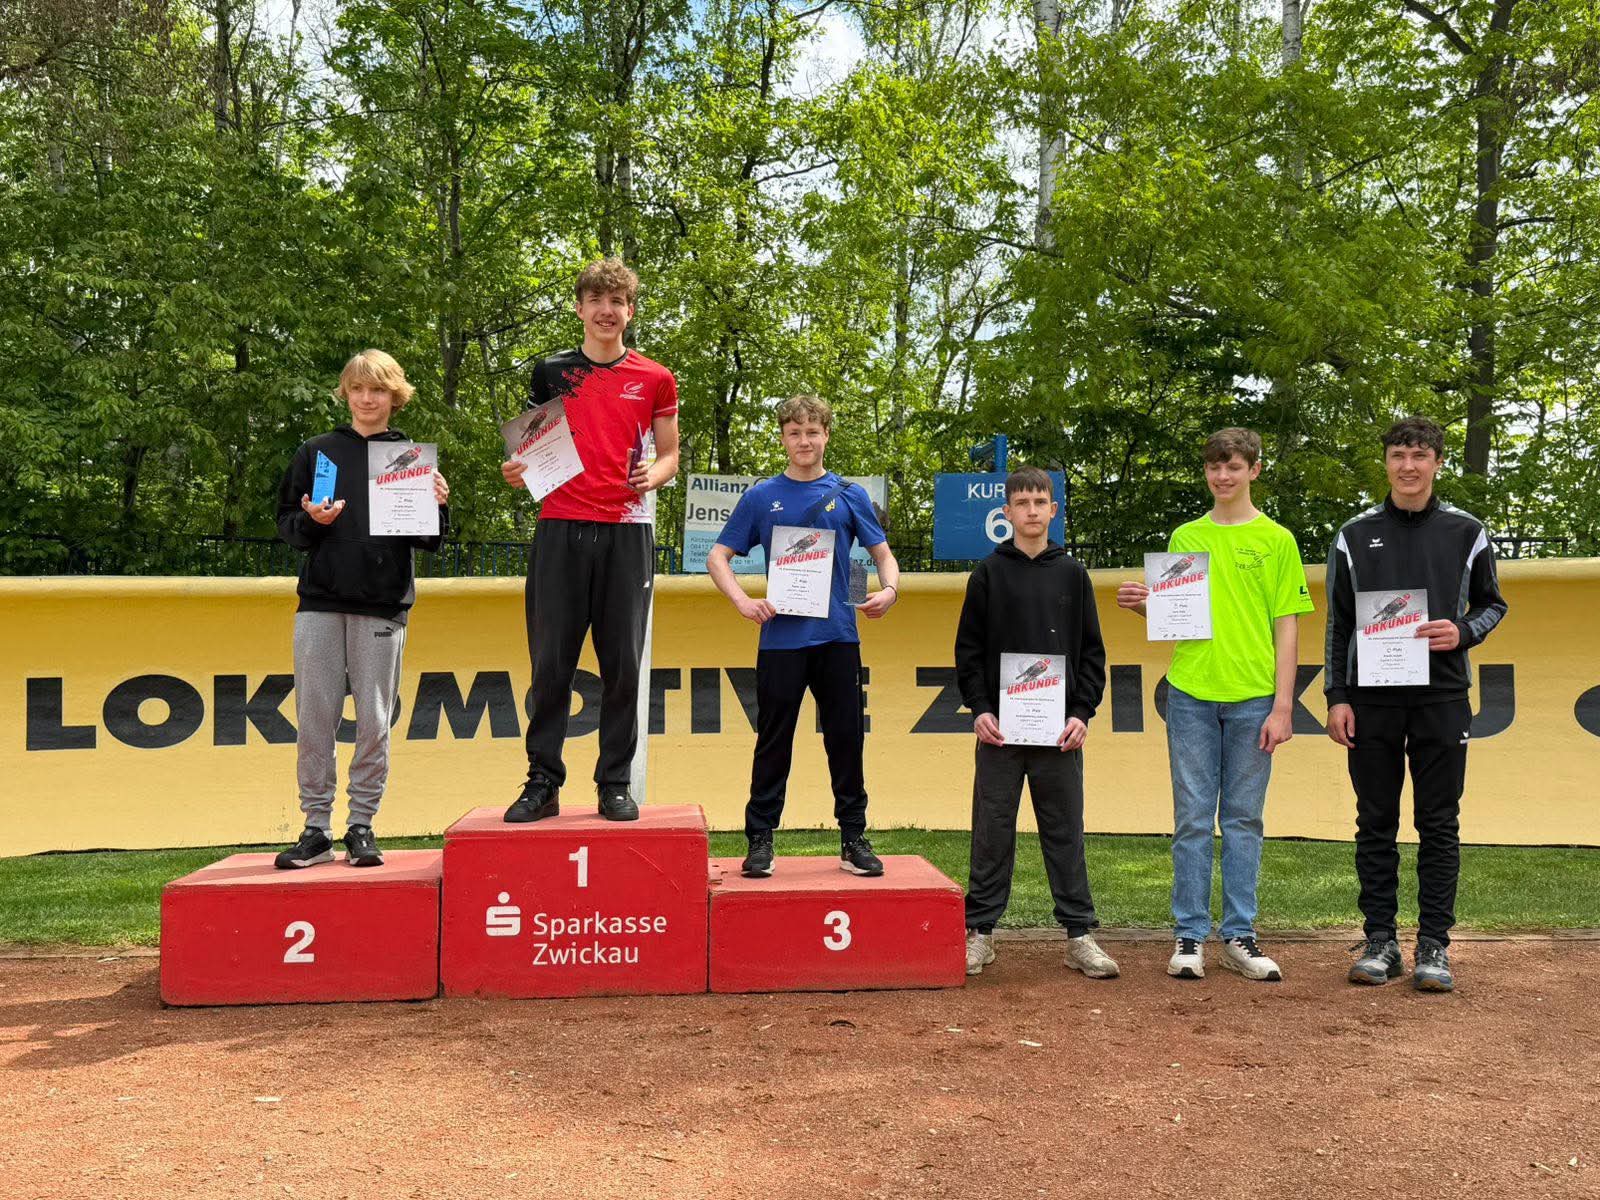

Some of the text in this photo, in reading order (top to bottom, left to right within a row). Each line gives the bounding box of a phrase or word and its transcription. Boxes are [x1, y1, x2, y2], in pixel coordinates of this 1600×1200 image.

[515, 417, 562, 455] URKUNDE
[376, 465, 432, 486] URKUNDE
[691, 477, 749, 493] Allianz
[967, 482, 1006, 498] KUR
[687, 502, 730, 521] Jens
[985, 507, 1014, 544] 6
[776, 550, 828, 567] URKUNDE
[1152, 571, 1205, 593] URKUNDE
[1364, 613, 1421, 636] URKUNDE
[1007, 676, 1060, 695] URKUNDE
[26, 667, 868, 751] LOKMOTI
[568, 846, 588, 887] 1
[533, 911, 667, 940] Sparkasse
[823, 910, 852, 951] 3
[283, 920, 316, 963] 2
[532, 941, 639, 965] Zwickau
